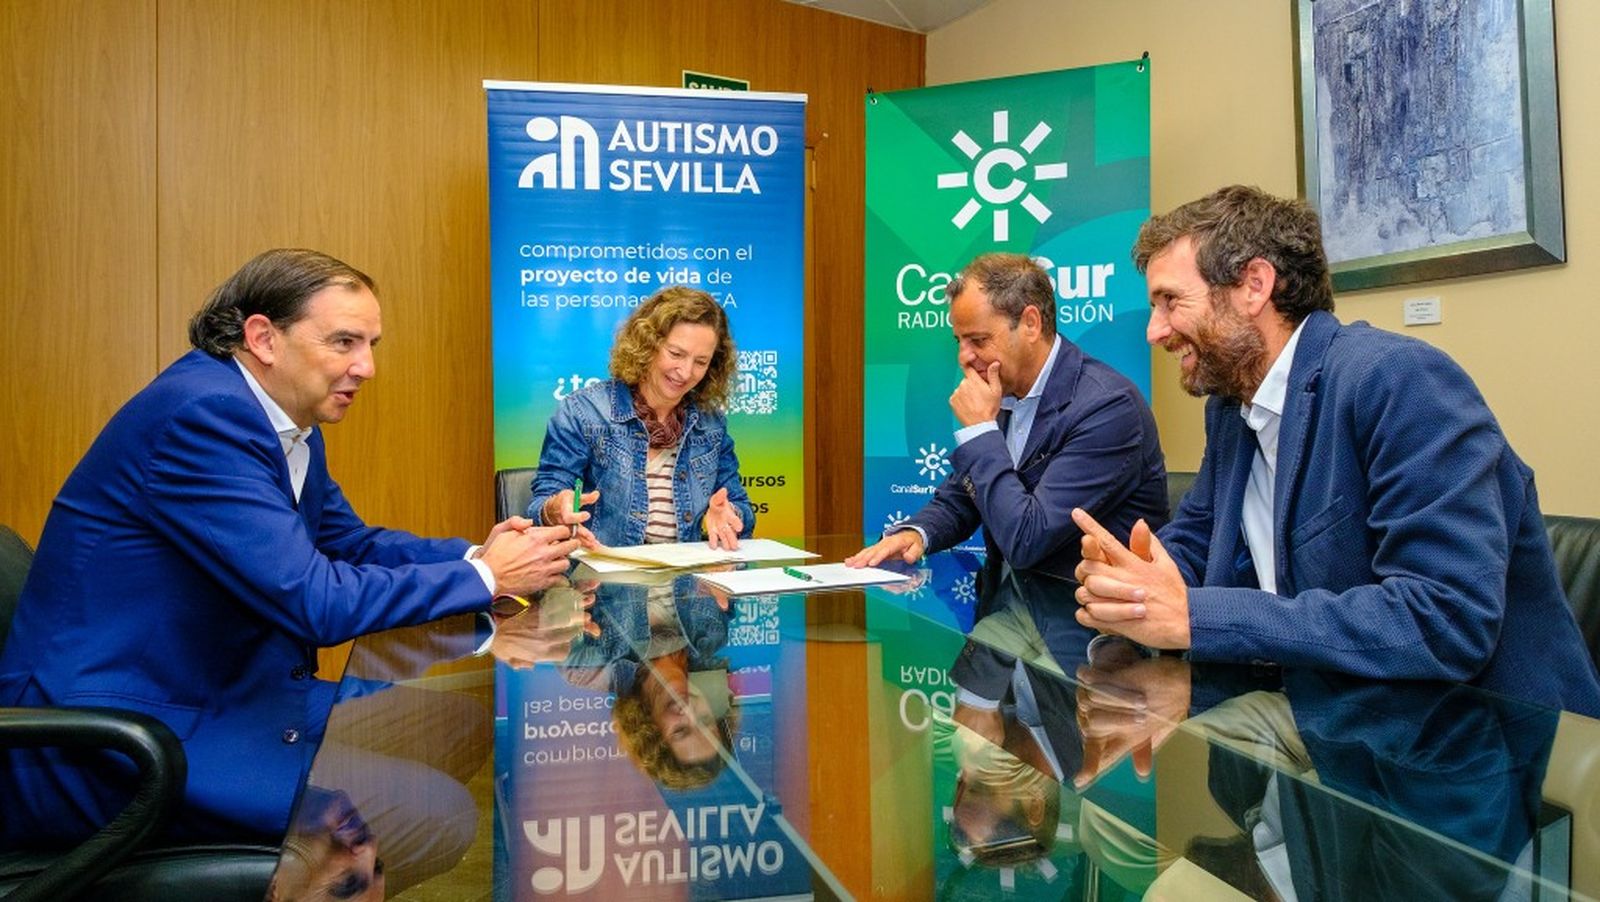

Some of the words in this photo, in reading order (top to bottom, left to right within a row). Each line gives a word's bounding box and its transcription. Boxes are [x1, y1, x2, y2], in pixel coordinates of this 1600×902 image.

[608, 119, 779, 156] AUTISMO
[609, 159, 761, 194] SEVILLA
[519, 243, 688, 261] comprometidos
[693, 247, 730, 260] con
[735, 244, 753, 260] el
[521, 268, 618, 286] proyecto
[624, 267, 651, 283] de
[657, 267, 701, 283] vida
[707, 268, 732, 284] de
[521, 290, 549, 307] las
[1059, 300, 1114, 324] SIÓN
